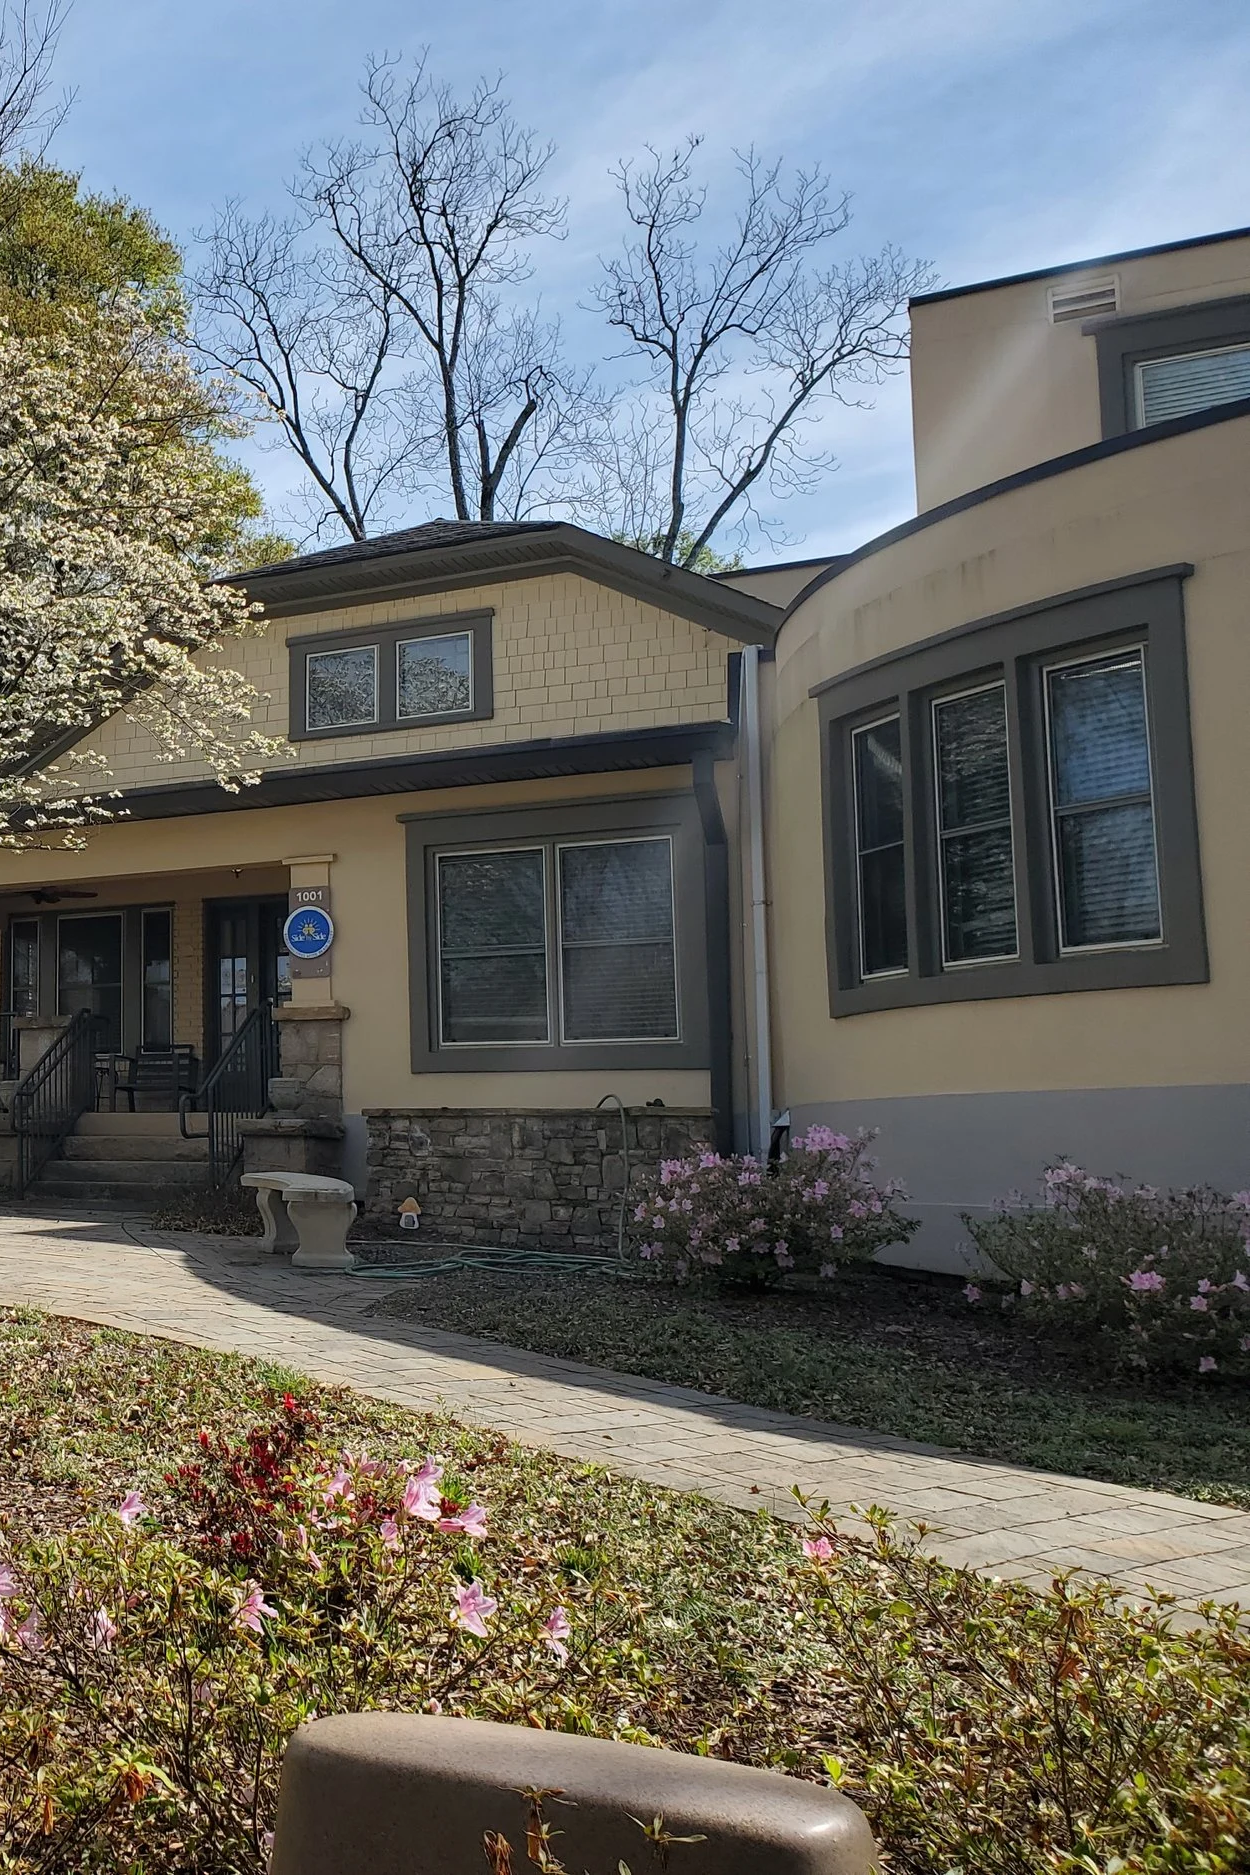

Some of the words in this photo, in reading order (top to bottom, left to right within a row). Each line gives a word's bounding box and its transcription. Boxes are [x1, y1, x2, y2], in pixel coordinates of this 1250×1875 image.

[296, 890, 323, 902] 1001
[291, 934, 306, 942] Side
[313, 932, 327, 941] Side
